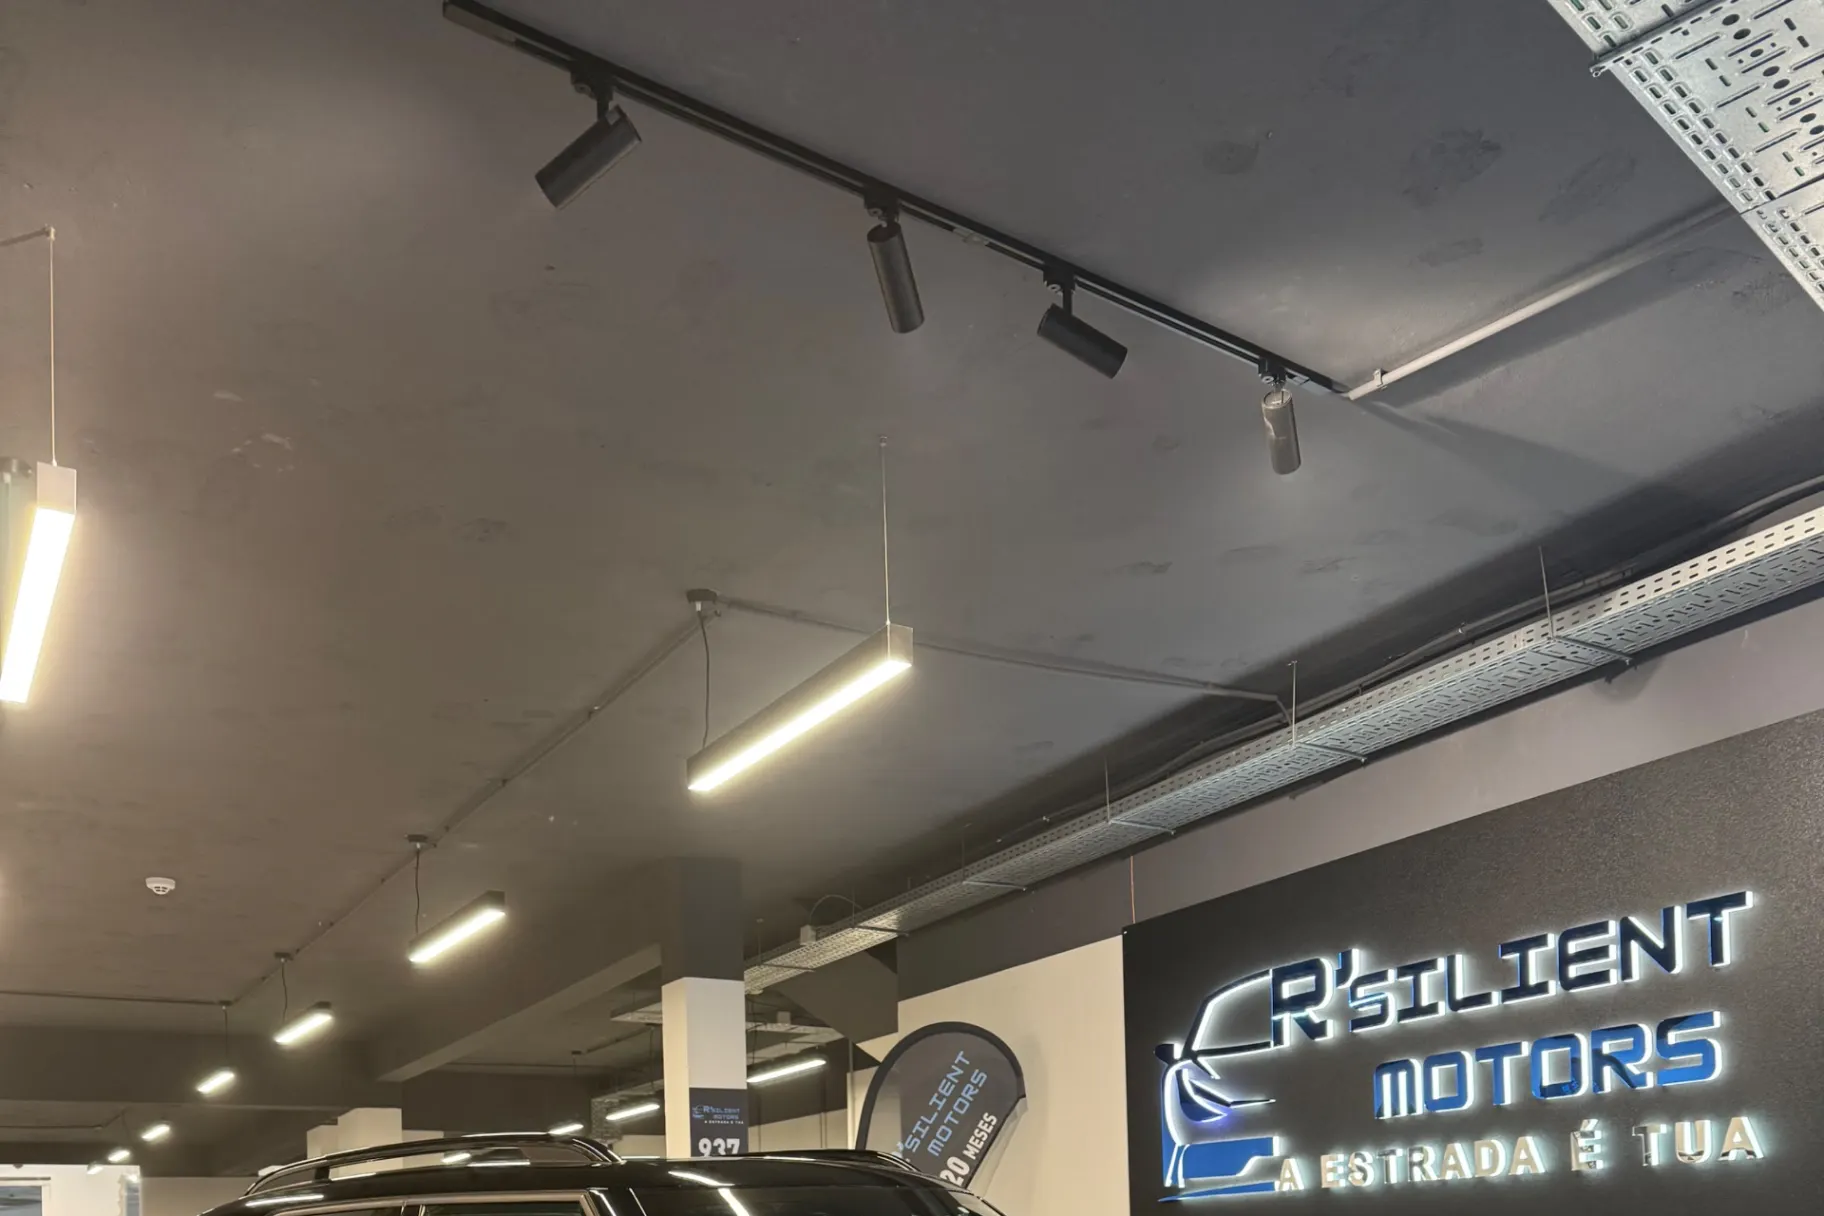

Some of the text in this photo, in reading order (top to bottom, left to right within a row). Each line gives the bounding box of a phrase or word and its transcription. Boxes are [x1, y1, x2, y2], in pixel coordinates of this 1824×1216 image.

[1271, 889, 1754, 1049] R'SILIENT
[1374, 1010, 1722, 1120] MOTORS
[927, 1069, 988, 1157] MOTORS
[962, 1112, 998, 1160] MESES
[1278, 1116, 1764, 1191] A ESTRADA É TUA
